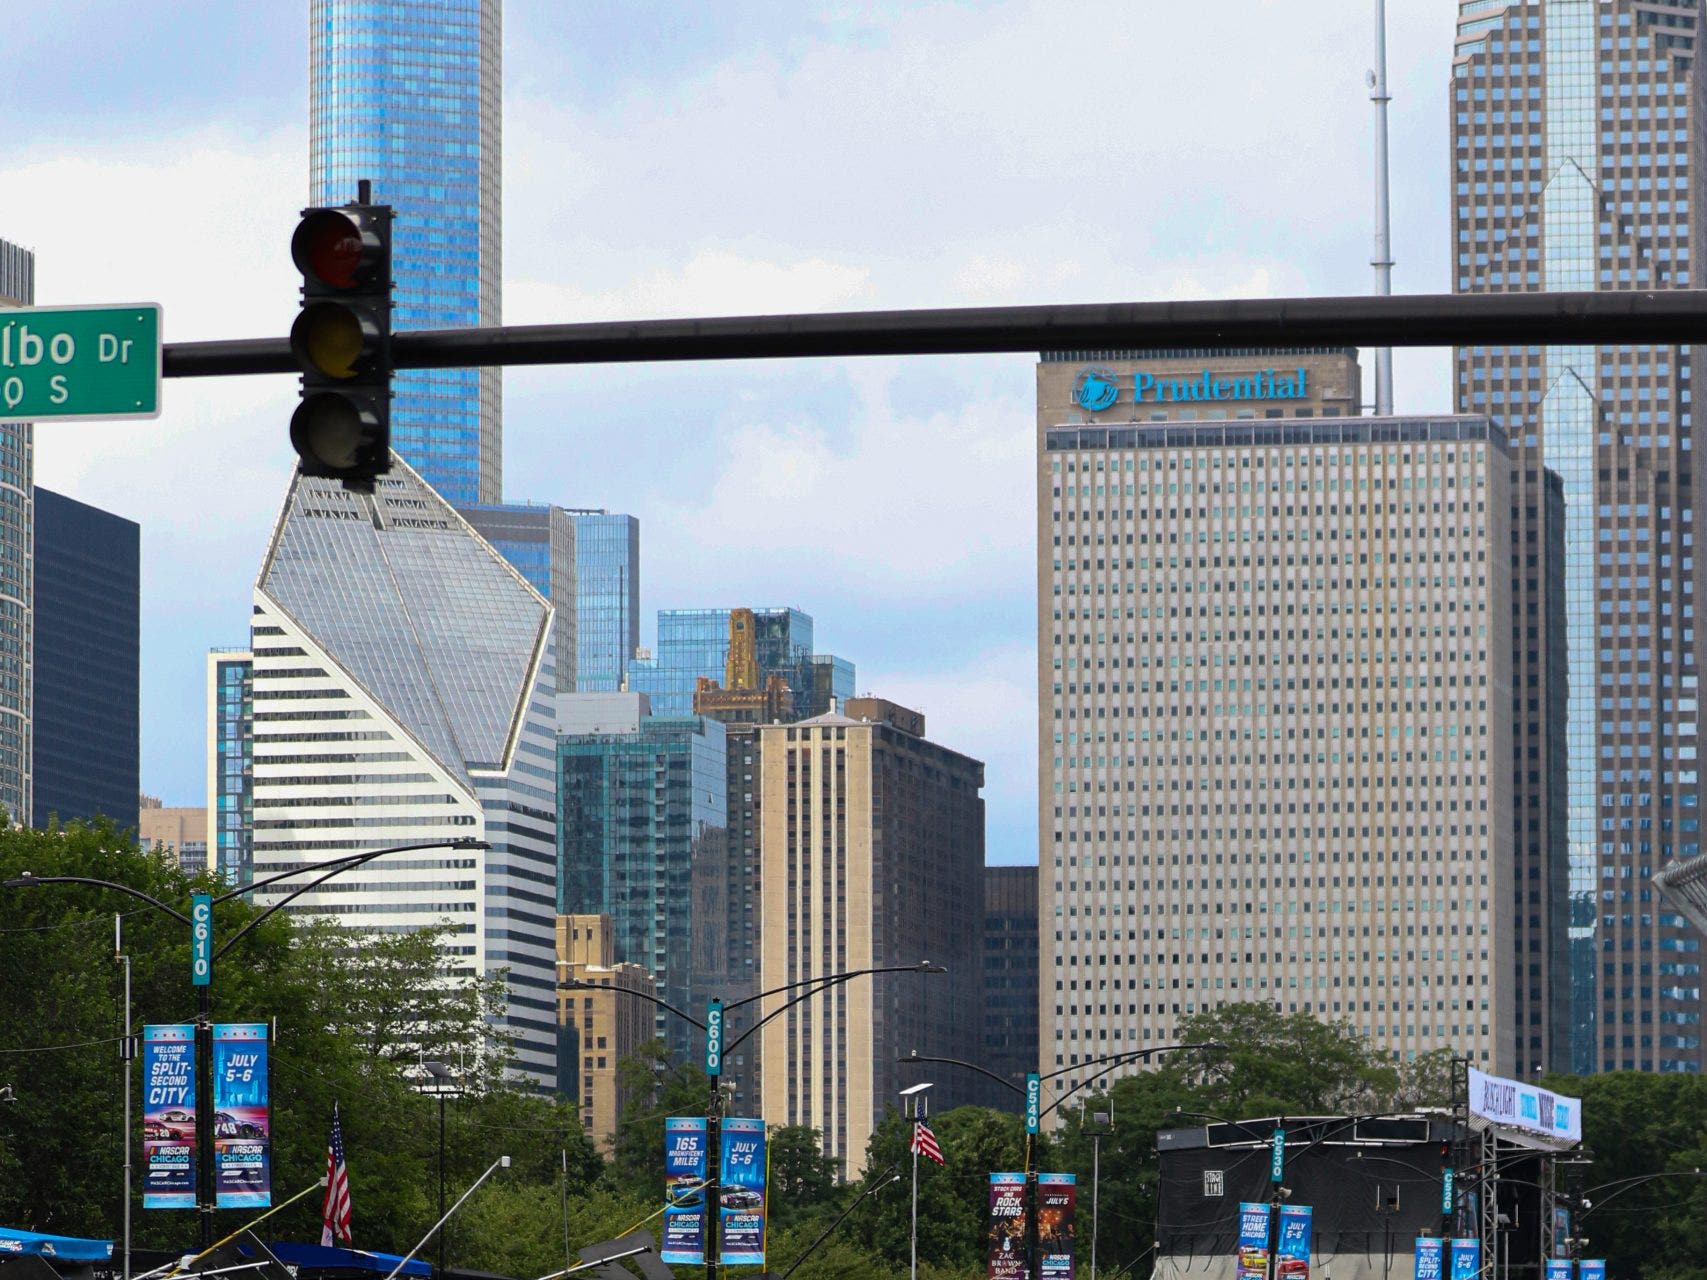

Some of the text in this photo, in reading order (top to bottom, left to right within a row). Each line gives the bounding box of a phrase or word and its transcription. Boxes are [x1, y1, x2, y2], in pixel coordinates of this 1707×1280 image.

[99, 333, 133, 365] Dr
[50, 375, 69, 404] S
[1133, 367, 1306, 402] Prudential
[193, 904, 209, 976] C610
[708, 1010, 720, 1068] C600
[153, 1045, 187, 1054] WELCOME
[158, 1054, 167, 1062] TO
[227, 1054, 258, 1067] JULY
[151, 1062, 192, 1075] SPLIT-
[150, 1076, 188, 1086] SECOND
[225, 1069, 253, 1082] 5-6
[149, 1087, 189, 1104] CITY
[1028, 1079, 1039, 1128] C540
[676, 1137, 698, 1150] 165
[731, 1142, 757, 1152] JULY
[160, 1146, 190, 1155] NASCAR
[232, 1145, 263, 1154] NASCAR
[150, 1155, 189, 1163] CHICAGO
[221, 1154, 263, 1162] CHICAGO
[730, 1154, 753, 1165] 5-6
[1273, 1135, 1283, 1176] C530
[673, 1157, 699, 1166] MILES
[1444, 1173, 1452, 1209] C520
[996, 1197, 1022, 1206] ROCK
[992, 1207, 1023, 1216] STARS
[1242, 1222, 1267, 1232] HOME
[1417, 1269, 1439, 1278] CITY
